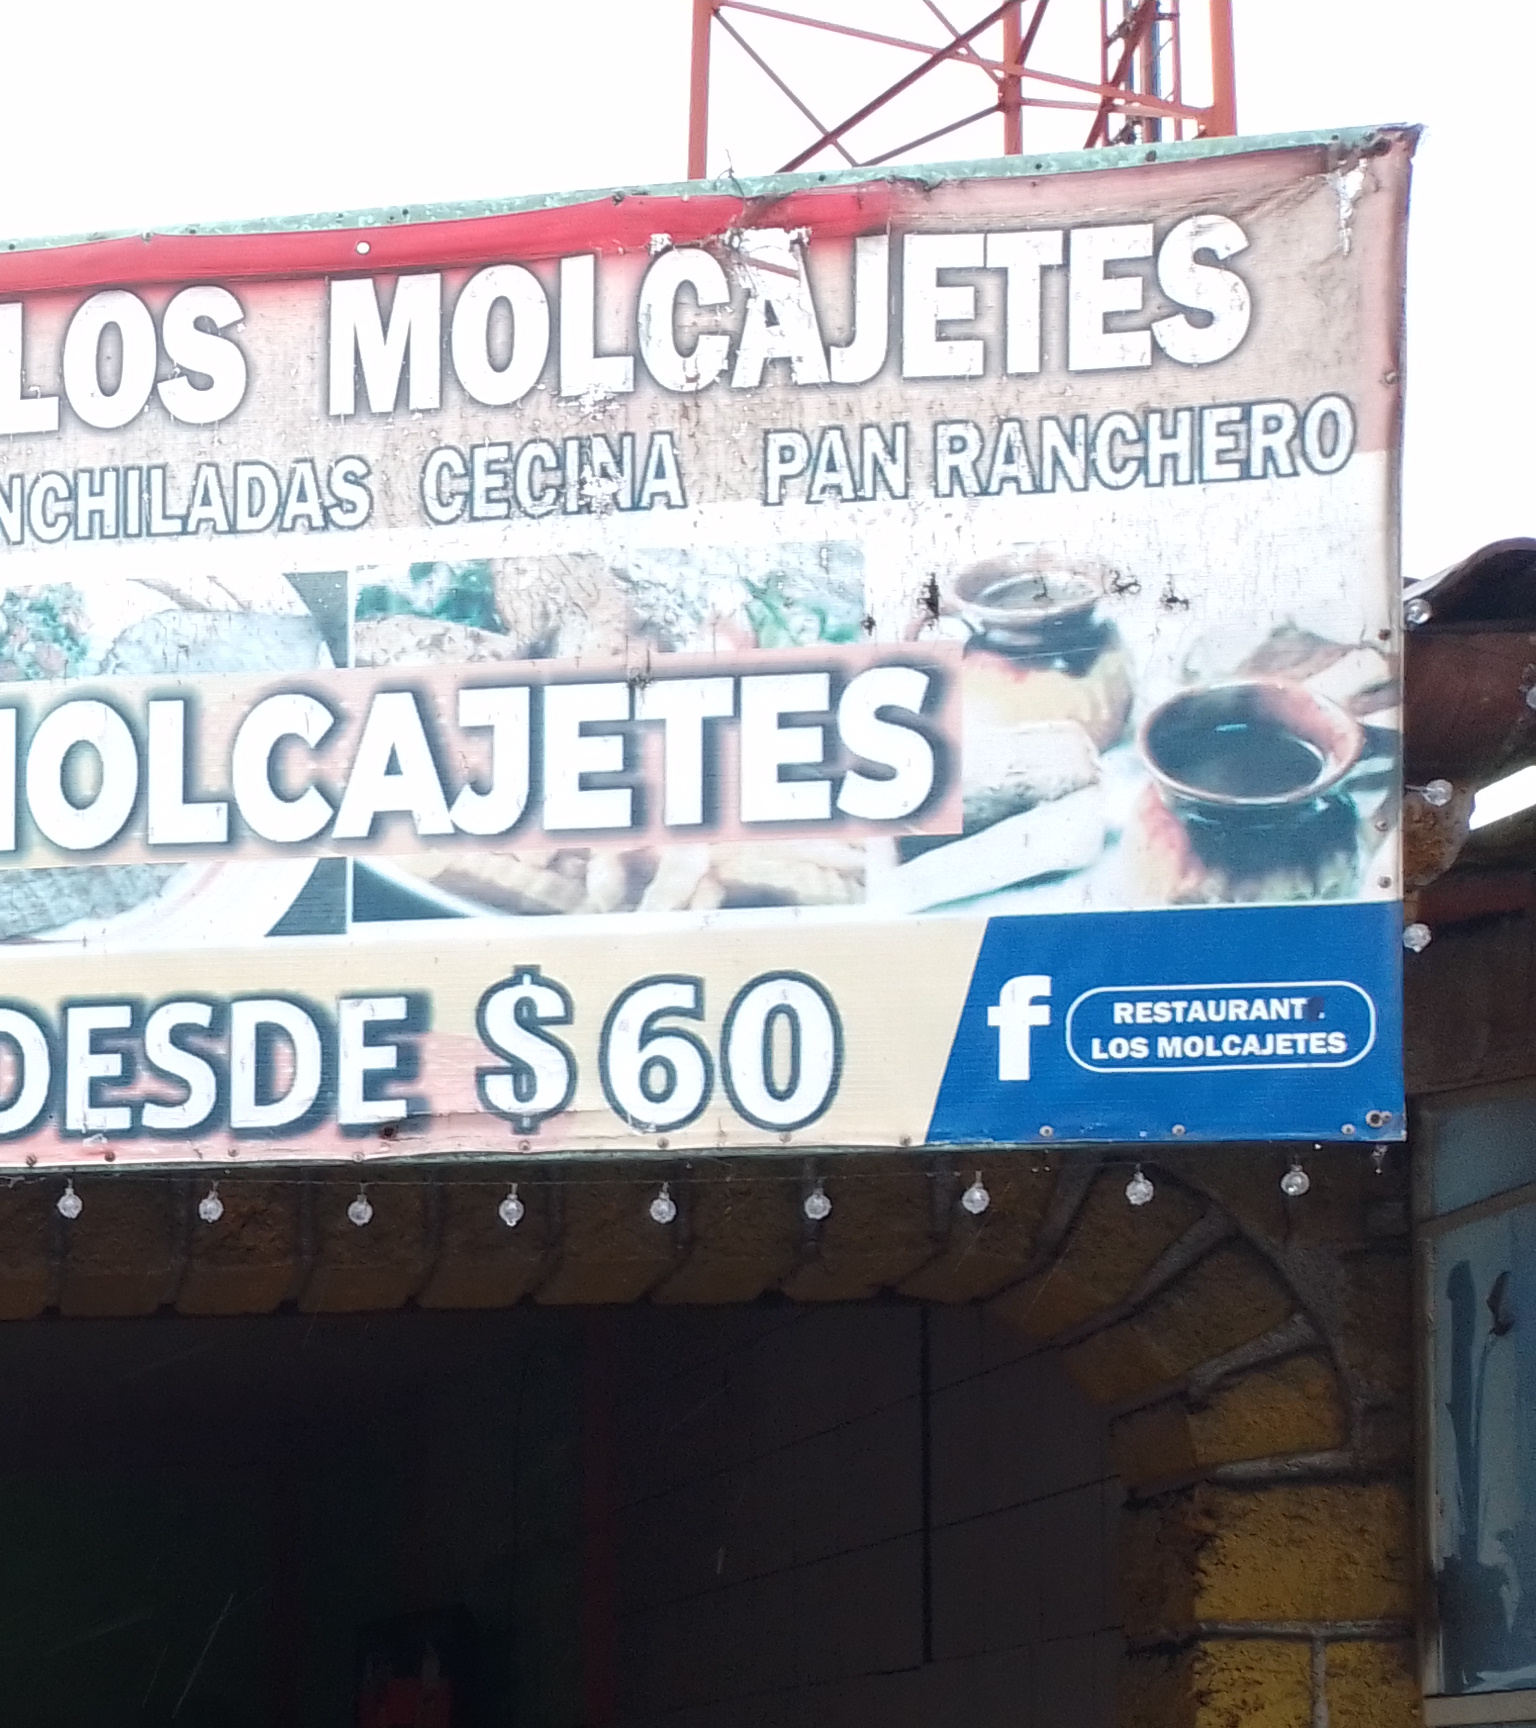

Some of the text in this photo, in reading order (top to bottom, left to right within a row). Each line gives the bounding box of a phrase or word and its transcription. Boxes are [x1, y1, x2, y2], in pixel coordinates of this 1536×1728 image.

[326, 214, 1255, 420] MOLCAJETES
[419, 429, 688, 526] CECINA
[764, 418, 911, 508] PAN
[934, 394, 1357, 501] RANCHERO
[477, 965, 844, 1136] $60
[1091, 1032, 1348, 1060] LOS MOLCAJETES
